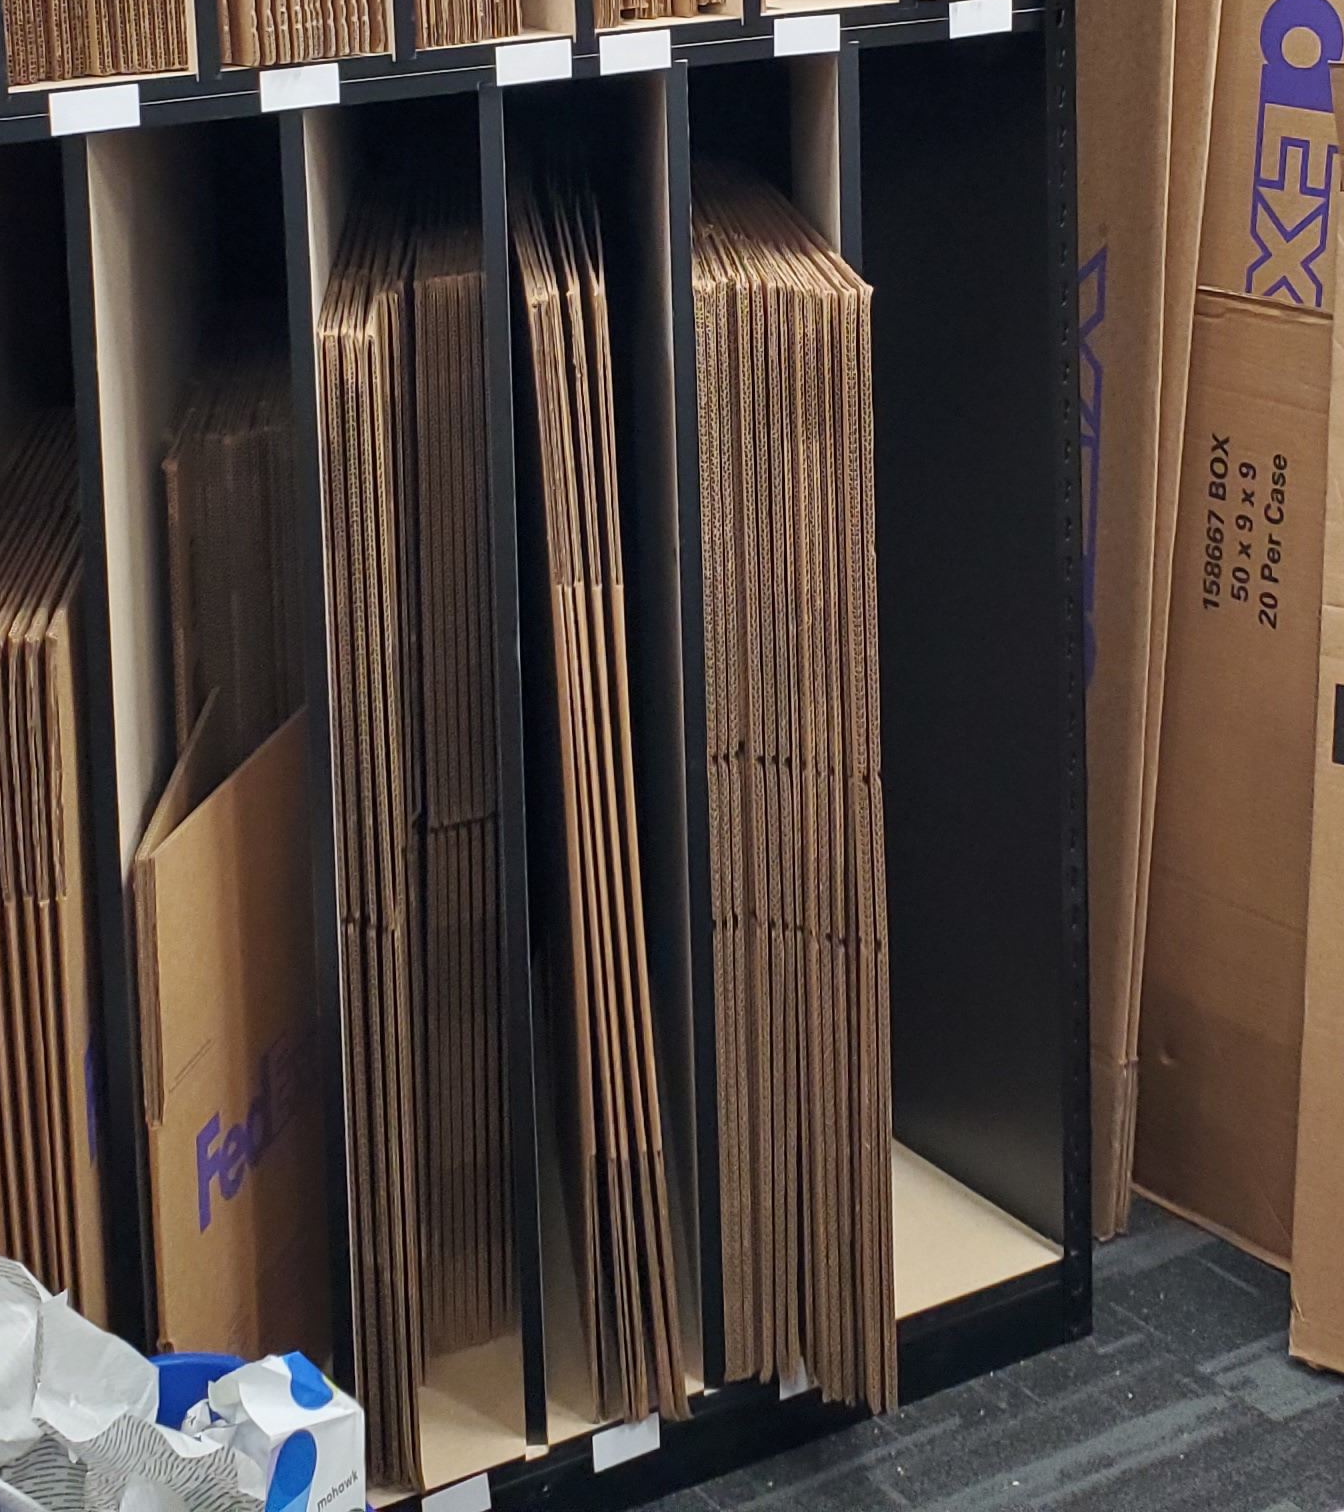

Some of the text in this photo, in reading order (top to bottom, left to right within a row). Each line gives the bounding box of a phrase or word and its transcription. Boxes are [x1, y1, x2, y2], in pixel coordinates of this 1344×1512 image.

[1202, 433, 1231, 611] 158667 BOX
[1230, 462, 1257, 603] 50 x 9 x 9
[1258, 454, 1288, 630] 20 Per Case
[316, 1470, 359, 1510] mohawk
